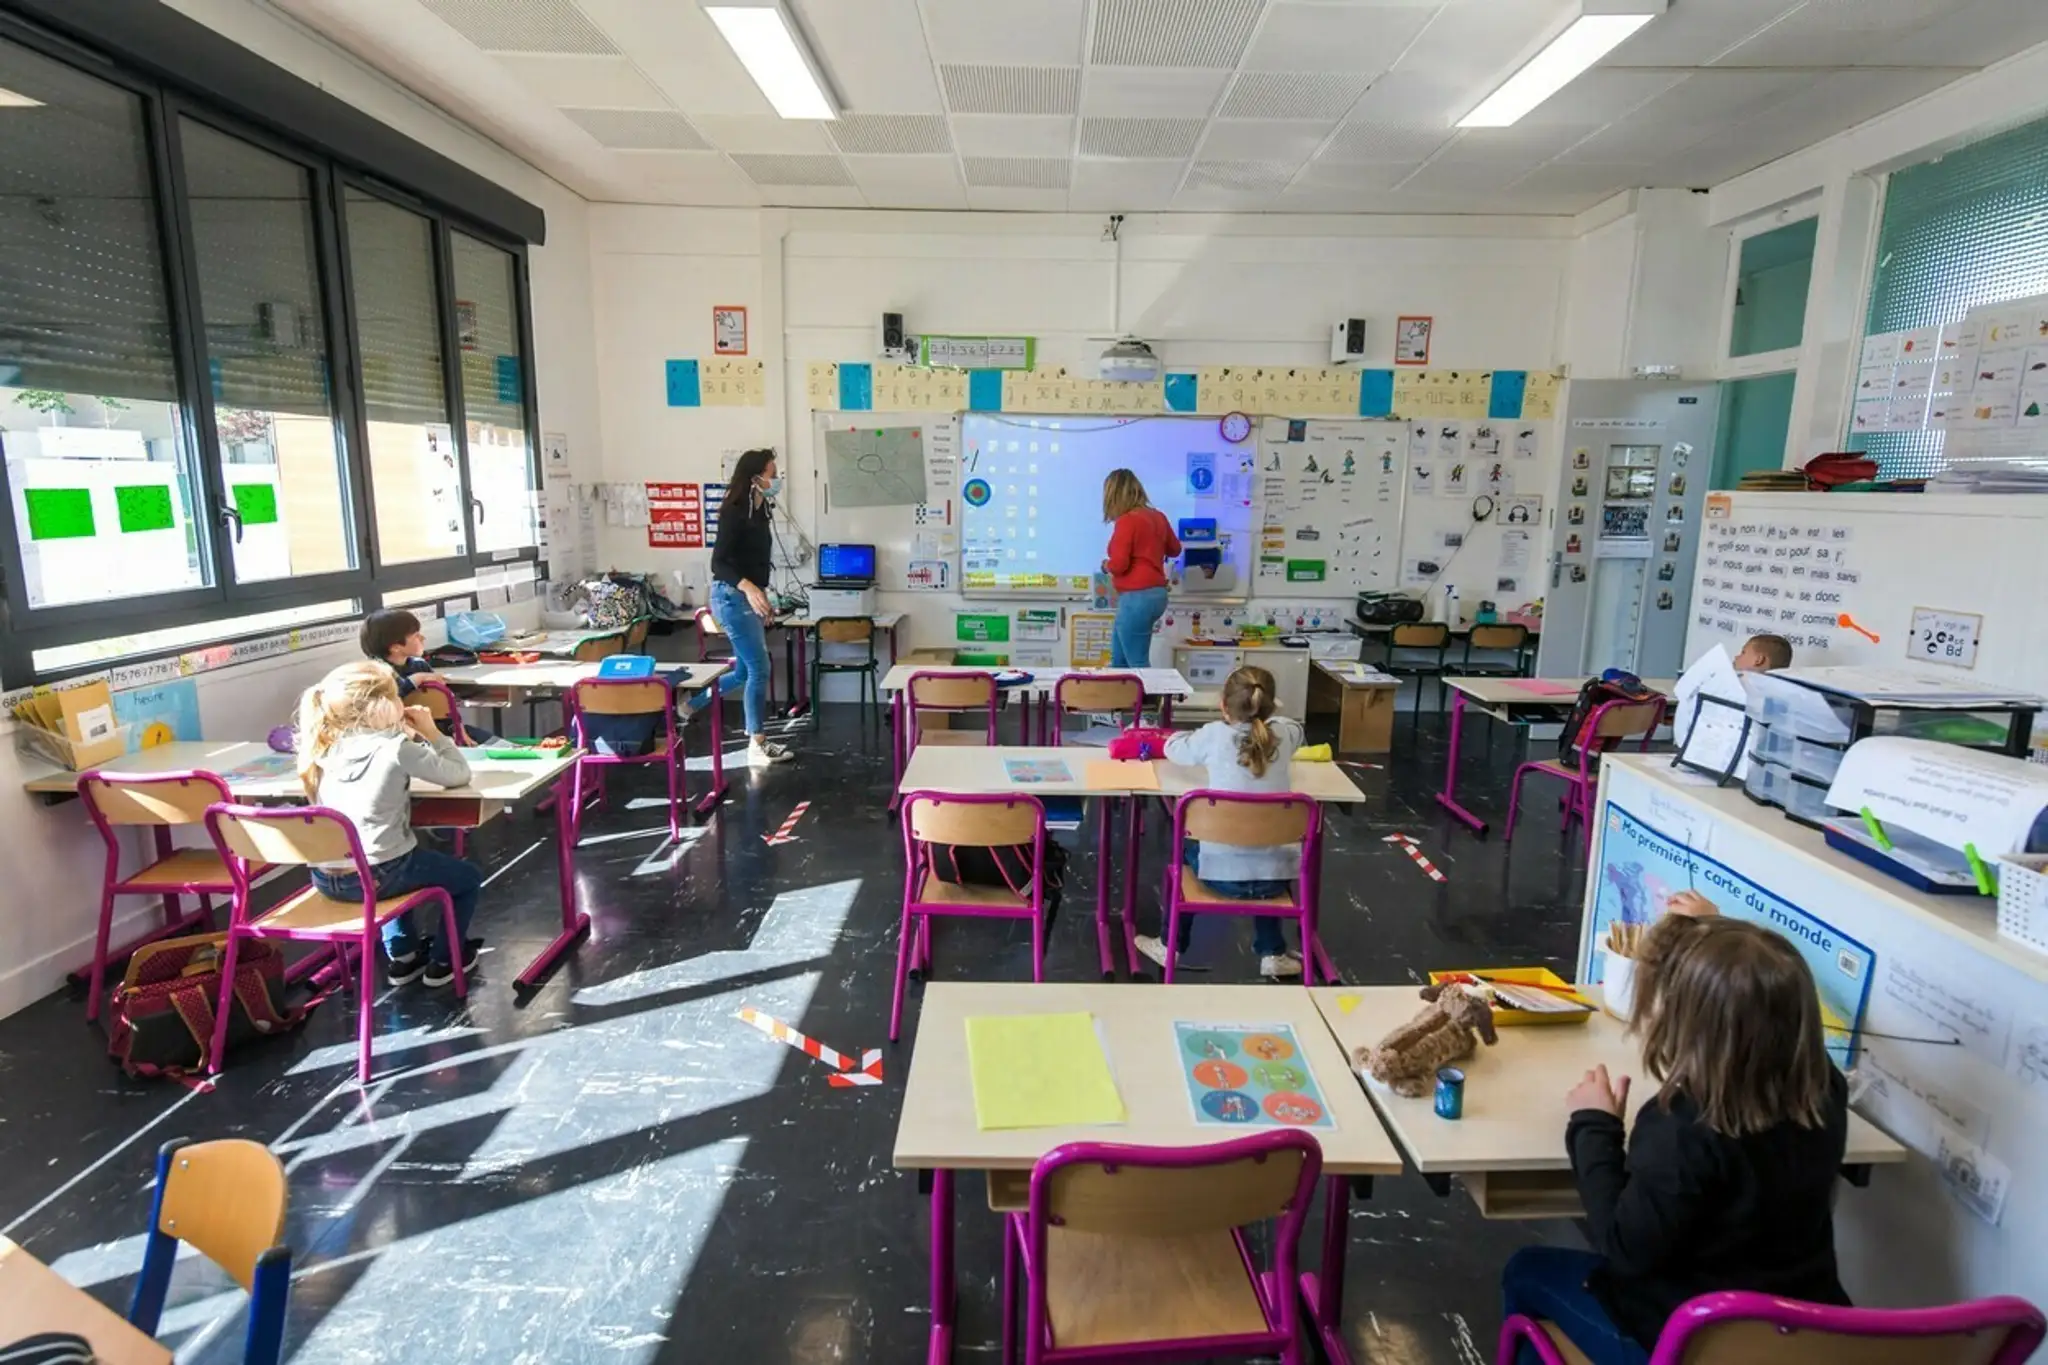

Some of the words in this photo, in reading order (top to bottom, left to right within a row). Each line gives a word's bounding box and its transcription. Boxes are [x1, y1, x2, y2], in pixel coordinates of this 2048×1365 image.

[1740, 525, 1756, 534] non
[1735, 543, 1750, 552] son
[1789, 545, 1812, 559] pour
[1816, 549, 1829, 558] sa
[1792, 566, 1805, 575] en
[1836, 571, 1858, 583] sans
[1799, 592, 1811, 601] se
[1815, 590, 1841, 603] donc
[1719, 600, 1753, 614] pourquoi
[1780, 608, 1797, 620] par
[1801, 613, 1836, 626] comme
[115, 672, 128, 681] 75
[129, 668, 141, 678] 76
[143, 667, 153, 676] 77
[156, 664, 168, 673] 78
[1621, 818, 1637, 840] Ma
[1636, 834, 1701, 876] première
[1703, 866, 1743, 900] carte
[1745, 892, 1766, 914] du
[1769, 908, 1833, 954] monde
